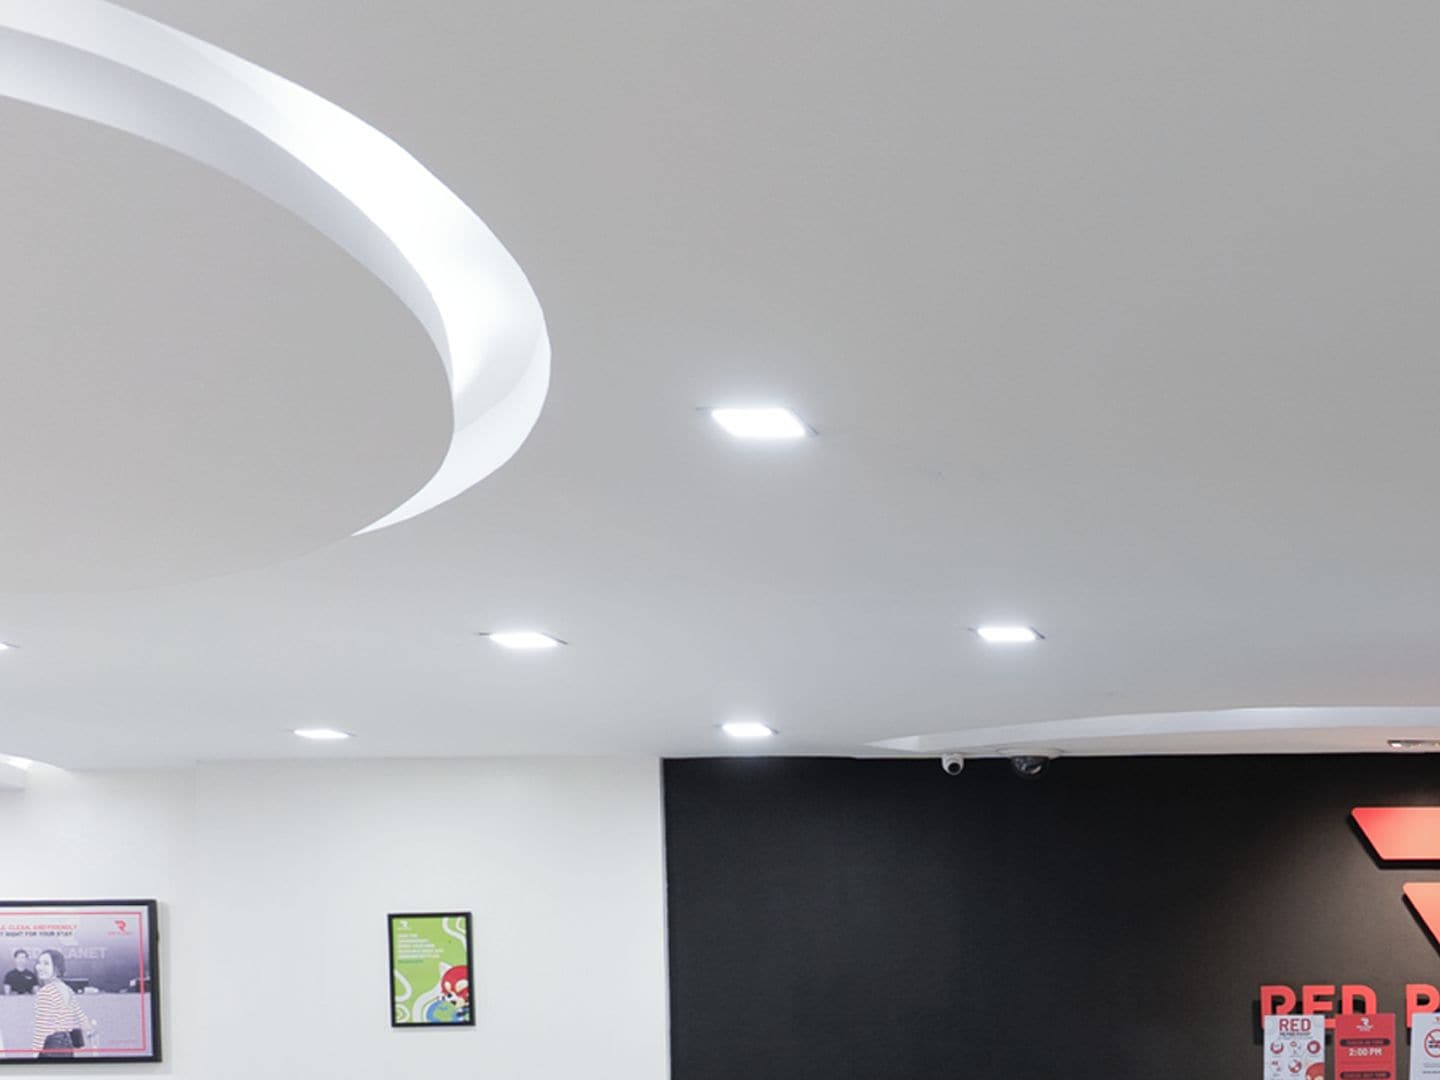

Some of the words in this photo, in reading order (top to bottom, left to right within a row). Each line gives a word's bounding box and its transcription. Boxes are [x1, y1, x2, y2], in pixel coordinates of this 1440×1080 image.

[1260, 985, 1378, 1029] RED
[1279, 1018, 1311, 1032] RED
[1349, 1047, 1368, 1056] 2:00
[1369, 1047, 1382, 1056] PM
